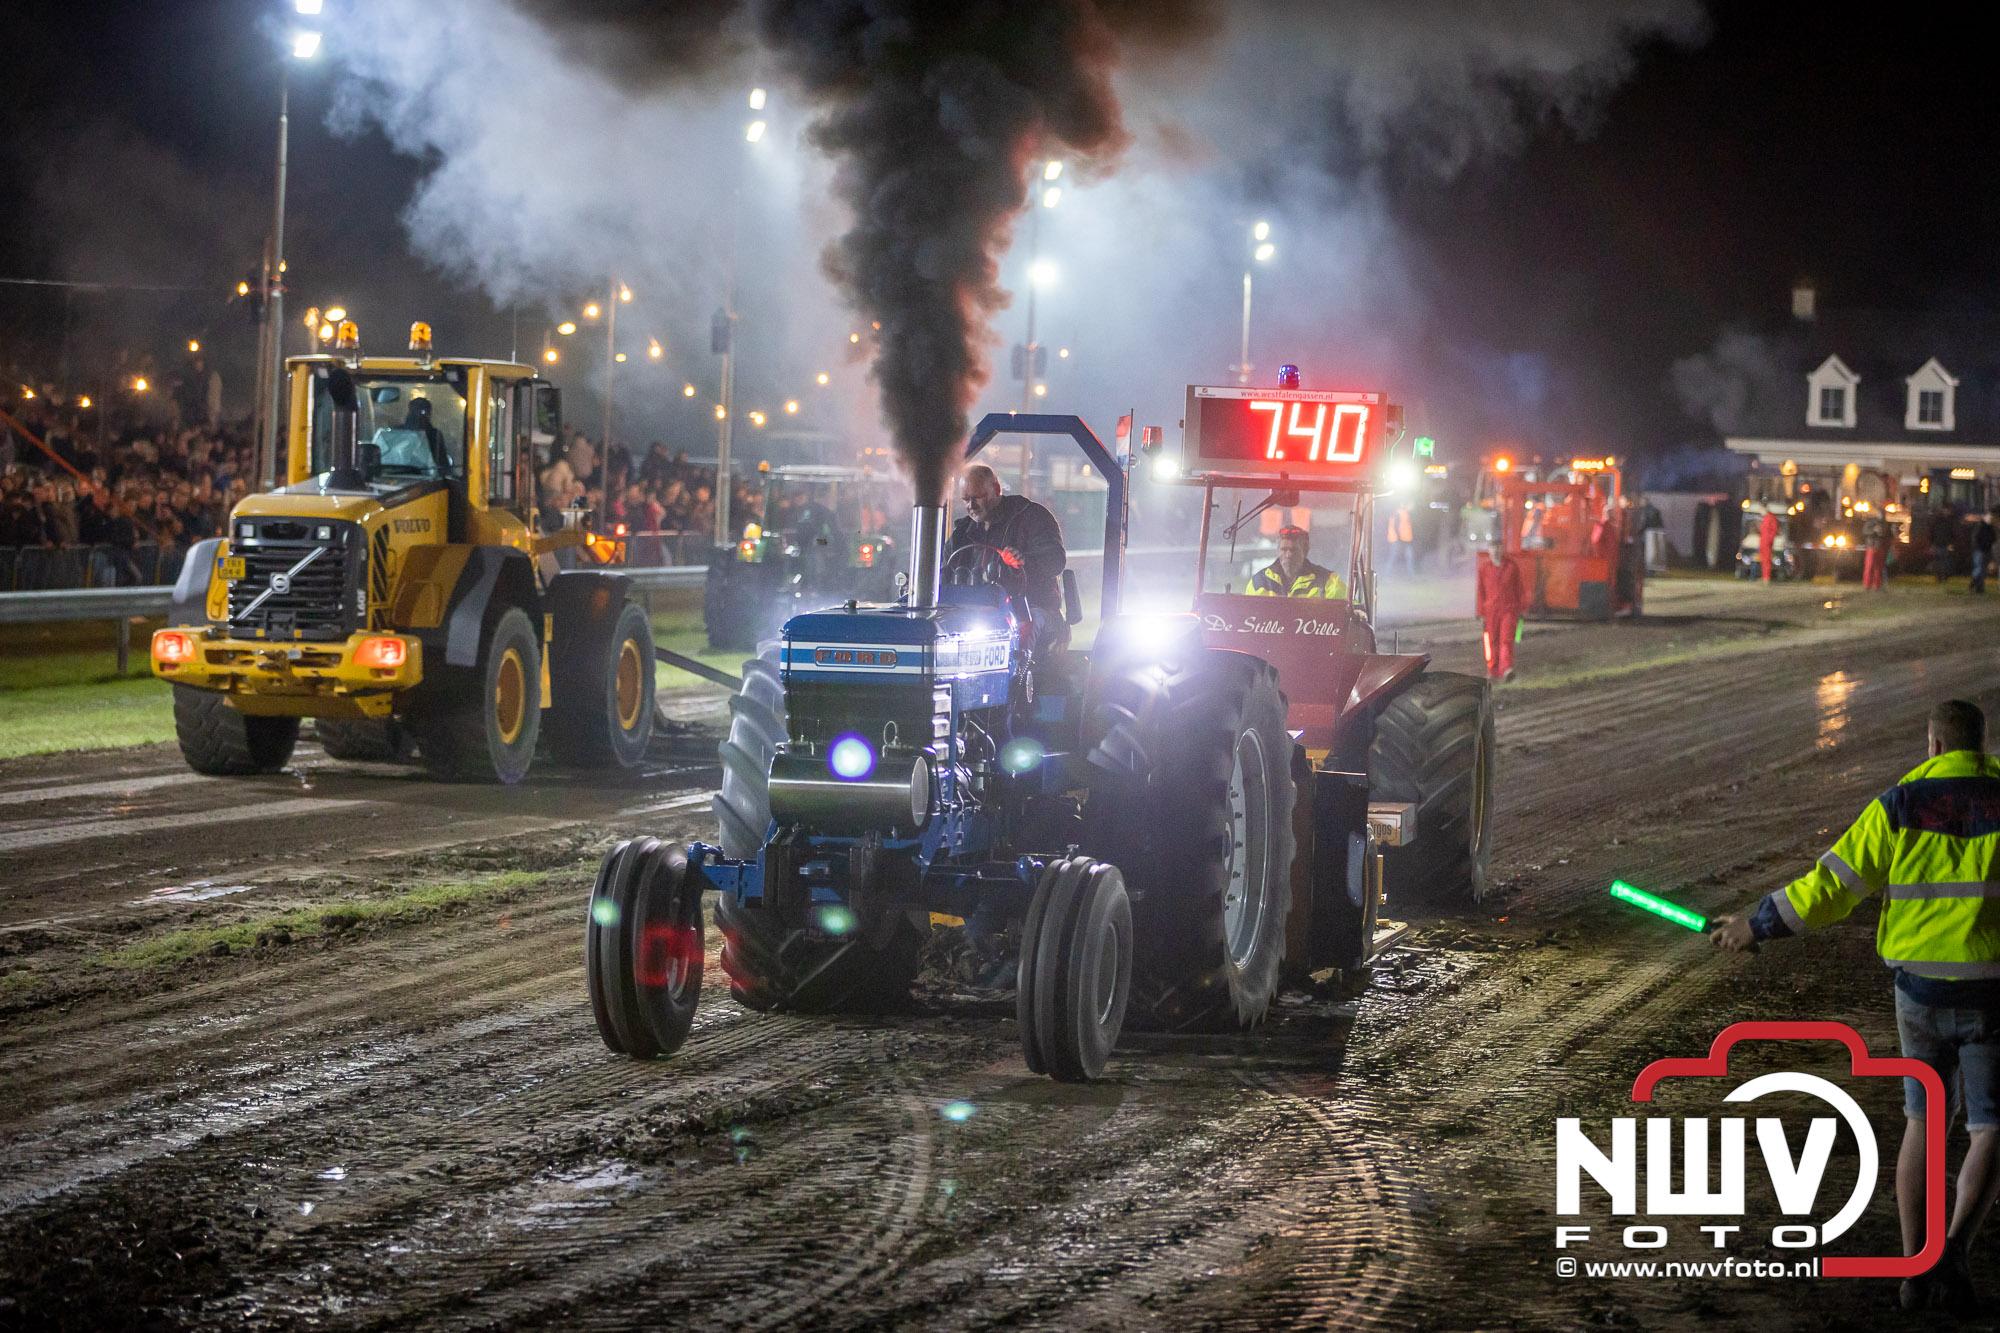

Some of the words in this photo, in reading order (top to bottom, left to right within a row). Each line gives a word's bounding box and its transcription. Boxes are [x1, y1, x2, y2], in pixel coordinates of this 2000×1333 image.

[1241, 389, 1333, 400] www.westfalengassen.nl
[1250, 401, 1368, 462] 7.40
[394, 519, 431, 533] VOLVO
[1204, 614, 1233, 631] De
[1237, 616, 1285, 634] Stille
[1295, 618, 1341, 636] Wille
[816, 649, 896, 665] FORD
[985, 645, 1005, 667] FORD
